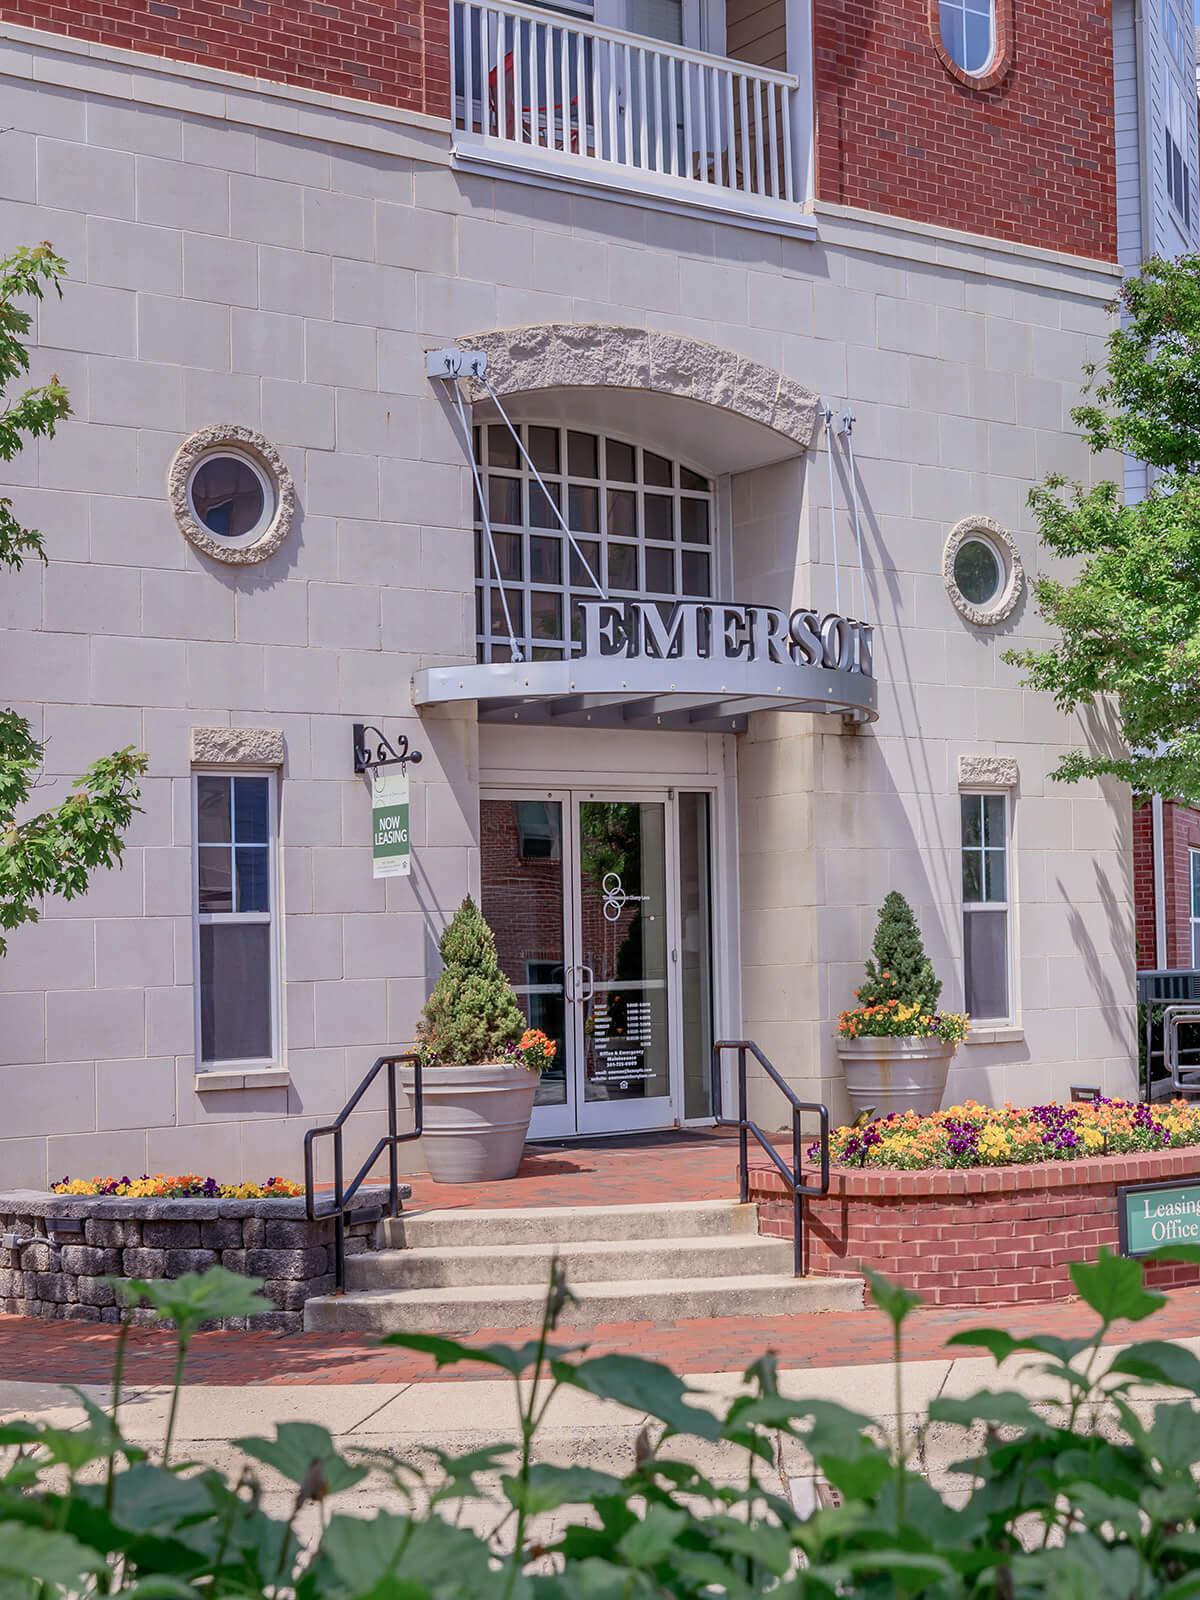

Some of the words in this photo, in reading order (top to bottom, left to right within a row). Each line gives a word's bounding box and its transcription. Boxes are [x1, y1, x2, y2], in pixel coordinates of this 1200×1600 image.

[577, 601, 875, 677] EMERSON
[379, 815, 401, 831] NOW
[375, 829, 408, 846] LEASING
[1151, 1219, 1199, 1241] Office
